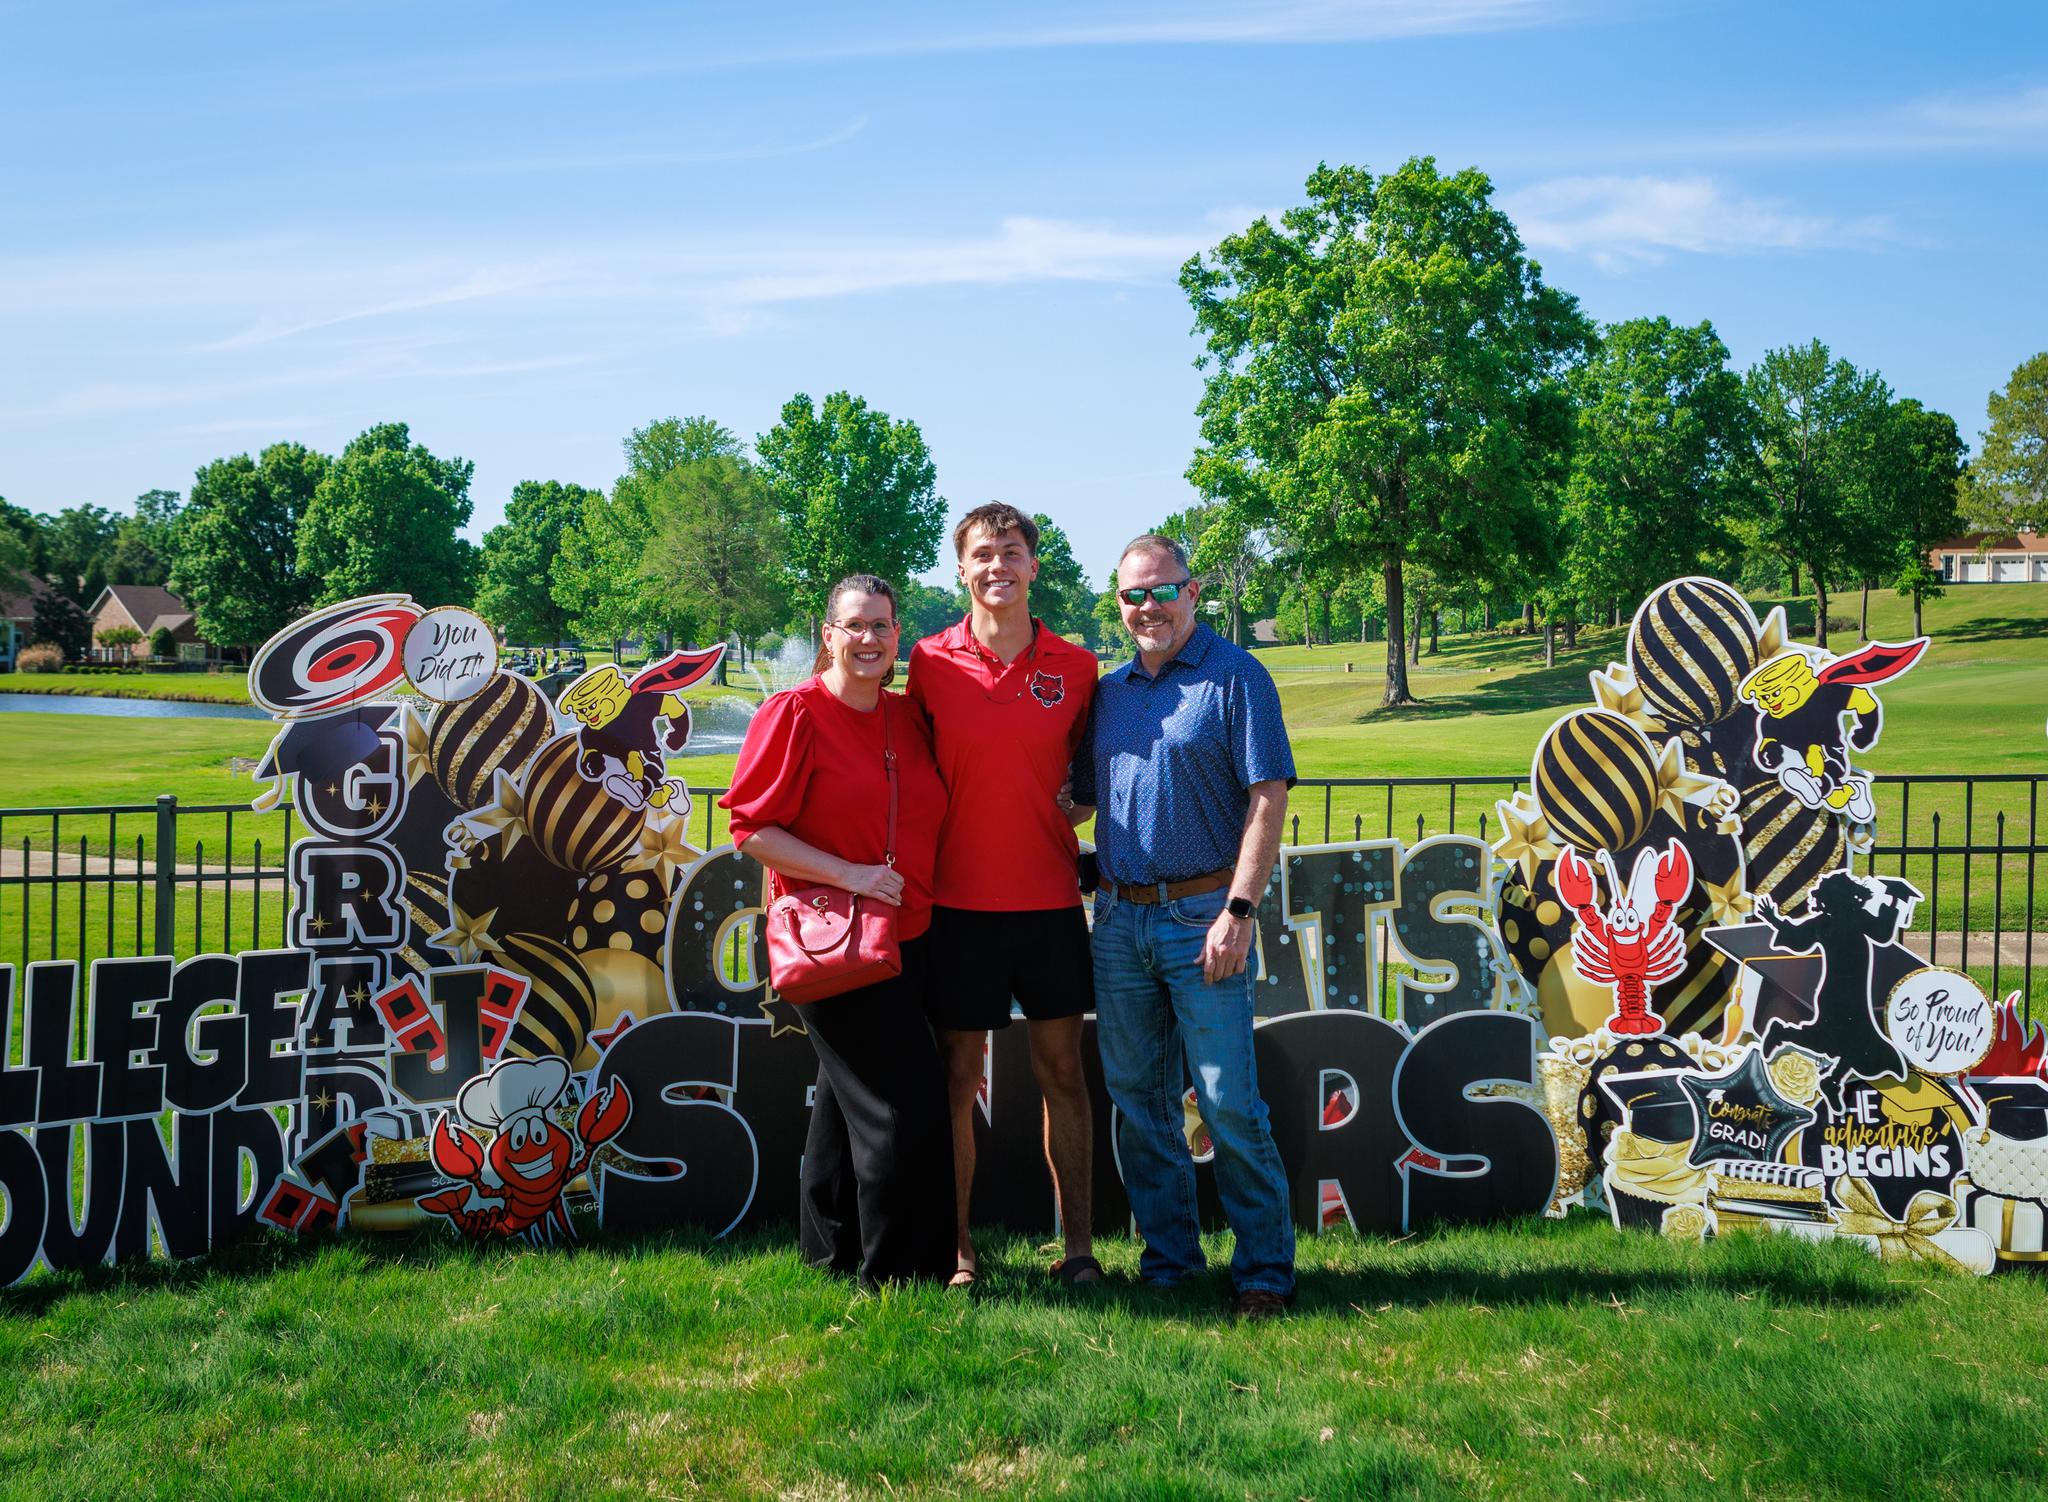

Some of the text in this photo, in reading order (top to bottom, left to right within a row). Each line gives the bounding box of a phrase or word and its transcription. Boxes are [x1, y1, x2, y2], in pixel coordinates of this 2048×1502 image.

[433, 622, 477, 657] You
[416, 656, 457, 684] Did
[1895, 989, 1984, 1027] So Proud
[1907, 1021, 1984, 1062] of You!
[1827, 1089, 1880, 1124] HE
[1709, 1122, 1767, 1151] GRAD!
[1823, 1114, 1939, 1154] adventure
[1820, 1143, 1950, 1178] BEGINS
